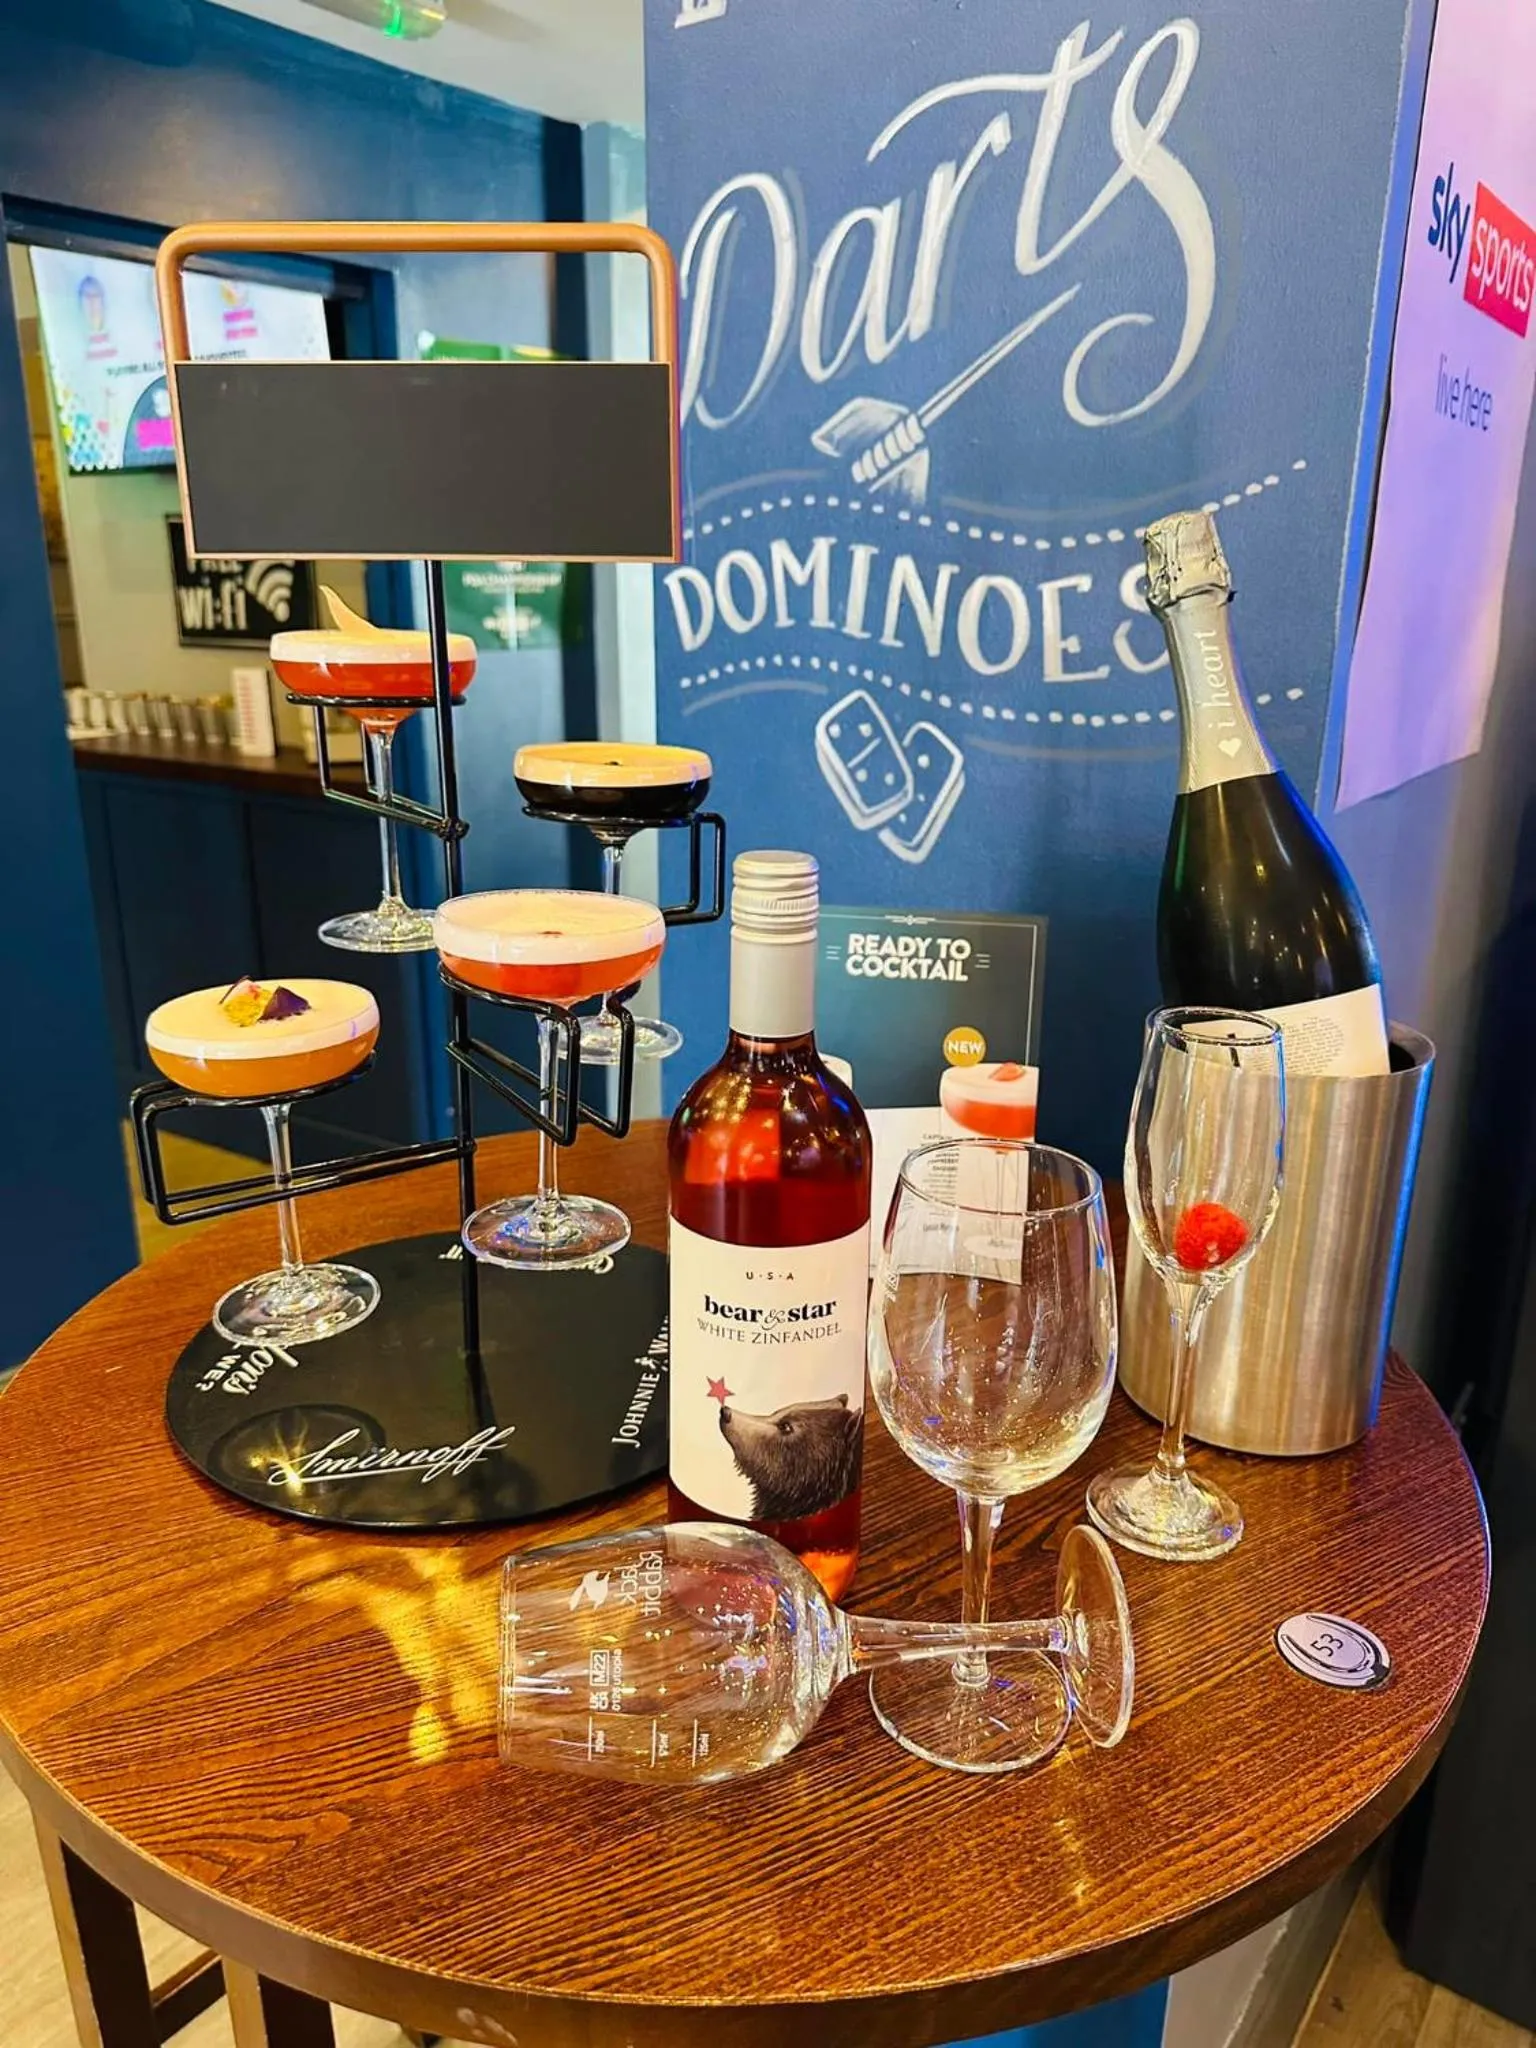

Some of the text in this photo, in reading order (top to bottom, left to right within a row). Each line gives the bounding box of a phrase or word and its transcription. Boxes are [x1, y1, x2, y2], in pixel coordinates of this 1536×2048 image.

[680, 15, 1218, 430] Darts
[1427, 161, 1535, 314] sky sports
[1435, 352, 1493, 433] live here
[663, 536, 1170, 684] DOMINOES
[1193, 628, 1233, 709] heart
[845, 956, 969, 982] COCKTAIL
[847, 933, 971, 960] READY TO
[946, 1041, 983, 1055] NEW
[697, 1317, 745, 1343] WHITE
[751, 1321, 842, 1345] ZINFANDEL
[704, 1294, 837, 1331] bear & star
[611, 1371, 661, 1449] JOHNNIE
[267, 1426, 516, 1486] Smirnoff
[593, 1653, 606, 1684] M22
[1310, 1633, 1343, 1657] 53
